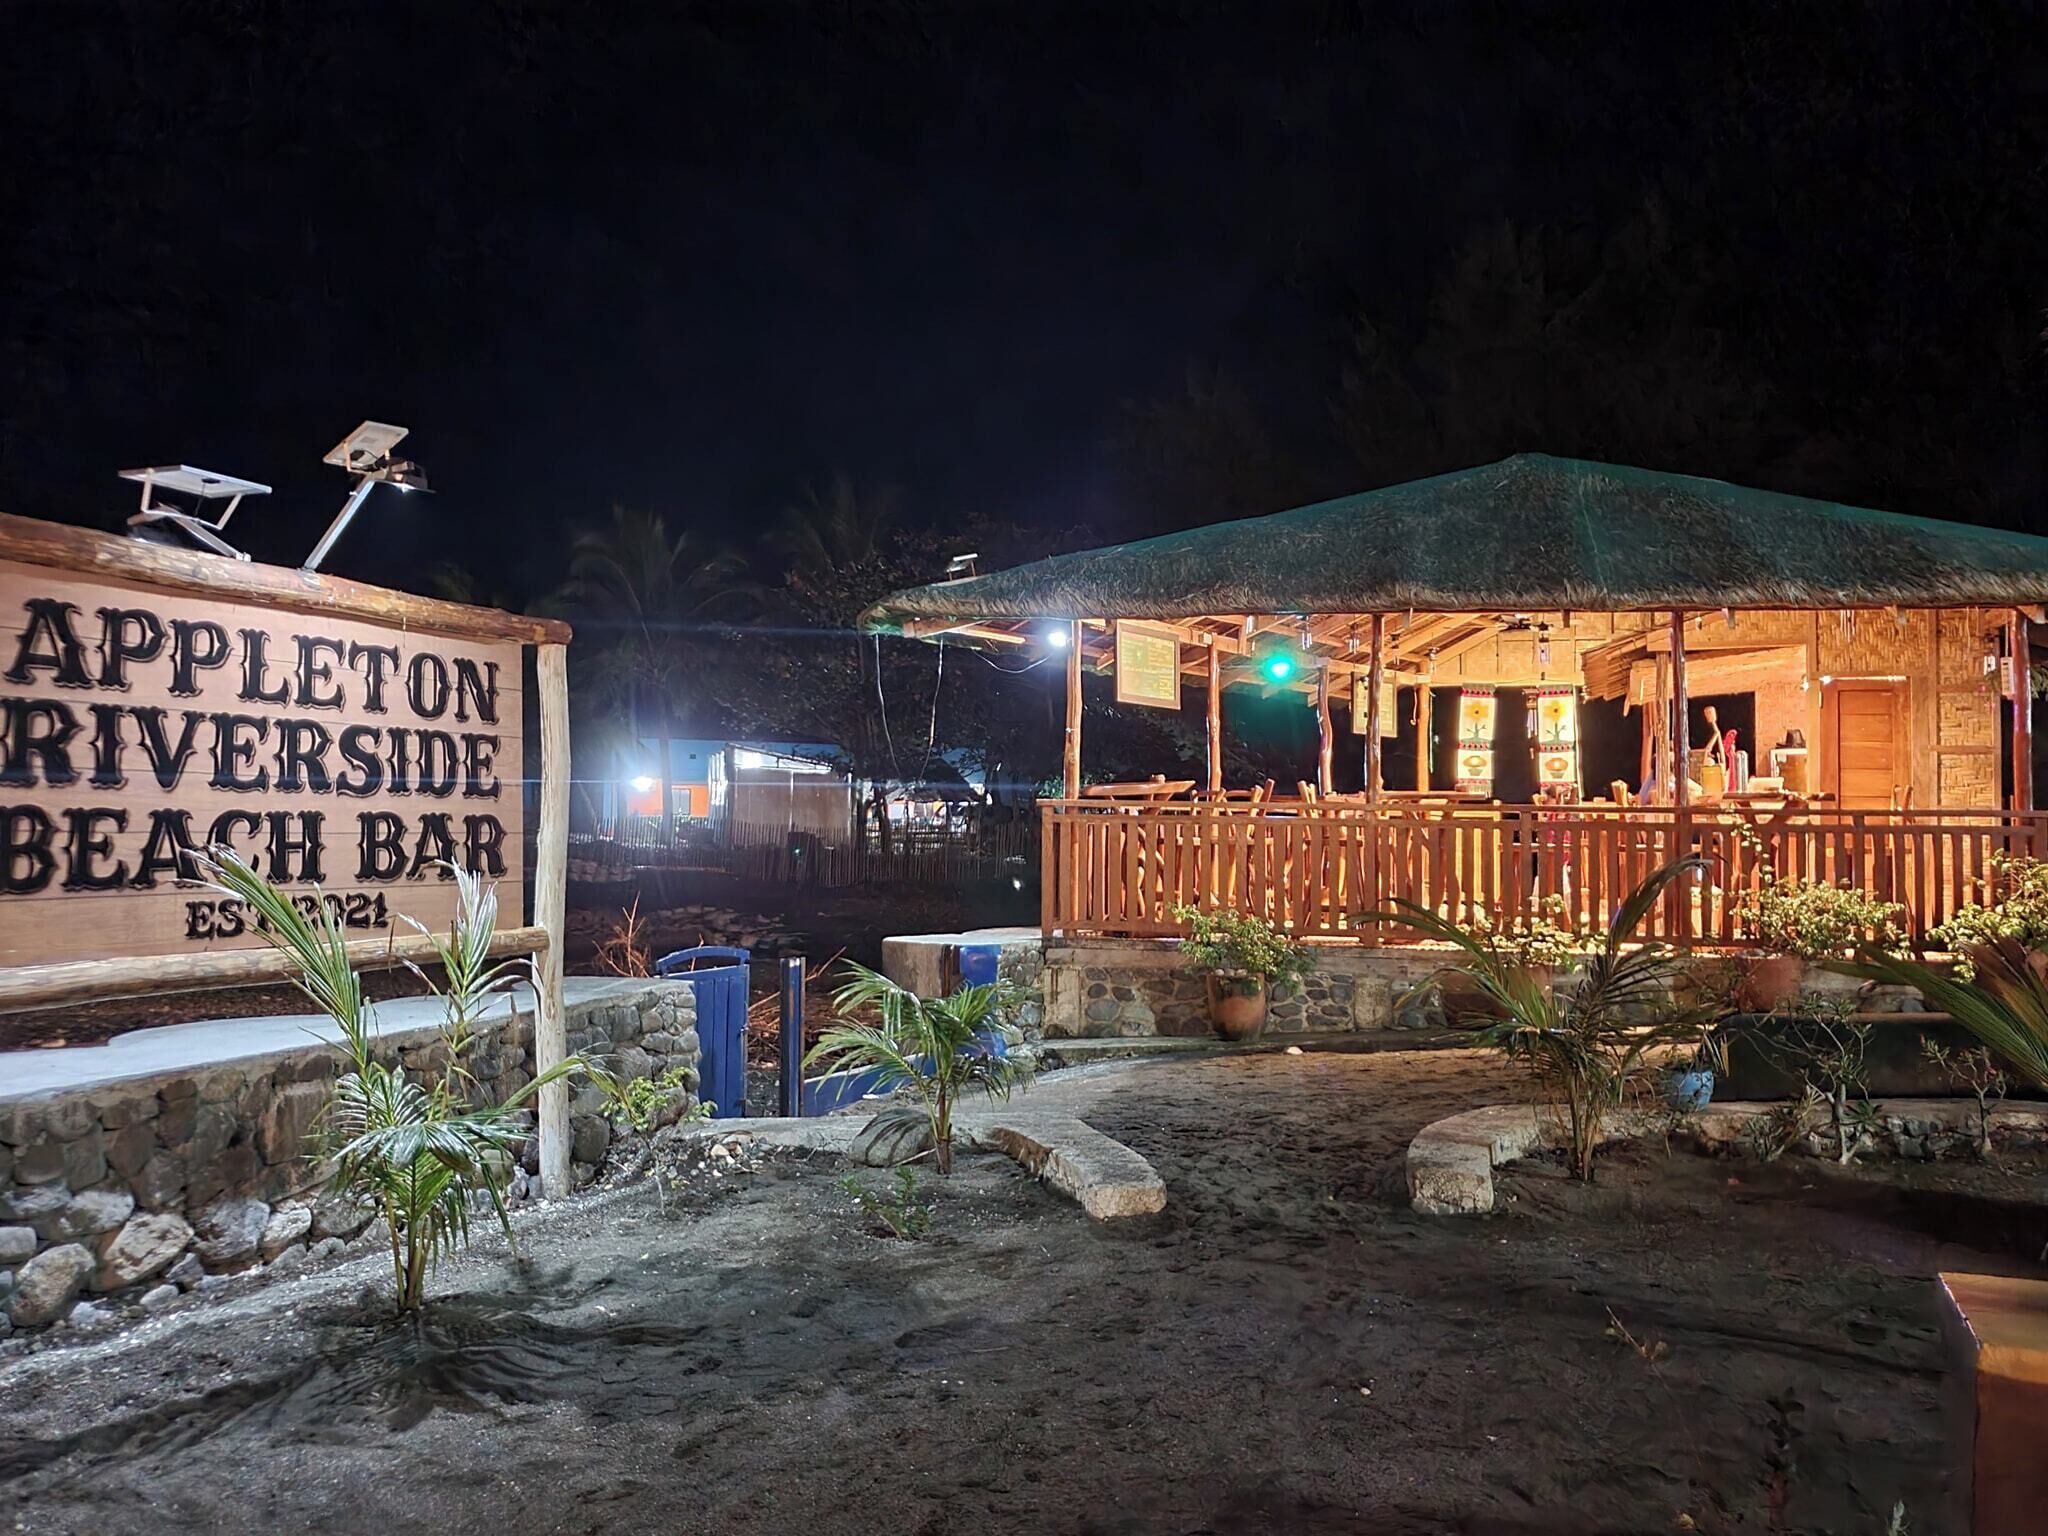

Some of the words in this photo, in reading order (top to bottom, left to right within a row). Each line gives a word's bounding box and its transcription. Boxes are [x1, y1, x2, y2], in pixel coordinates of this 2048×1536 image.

[3, 598, 500, 725] APPLETON
[0, 697, 501, 799] RIVERSIDE
[0, 803, 327, 895] BEACH
[354, 810, 507, 882] BAR
